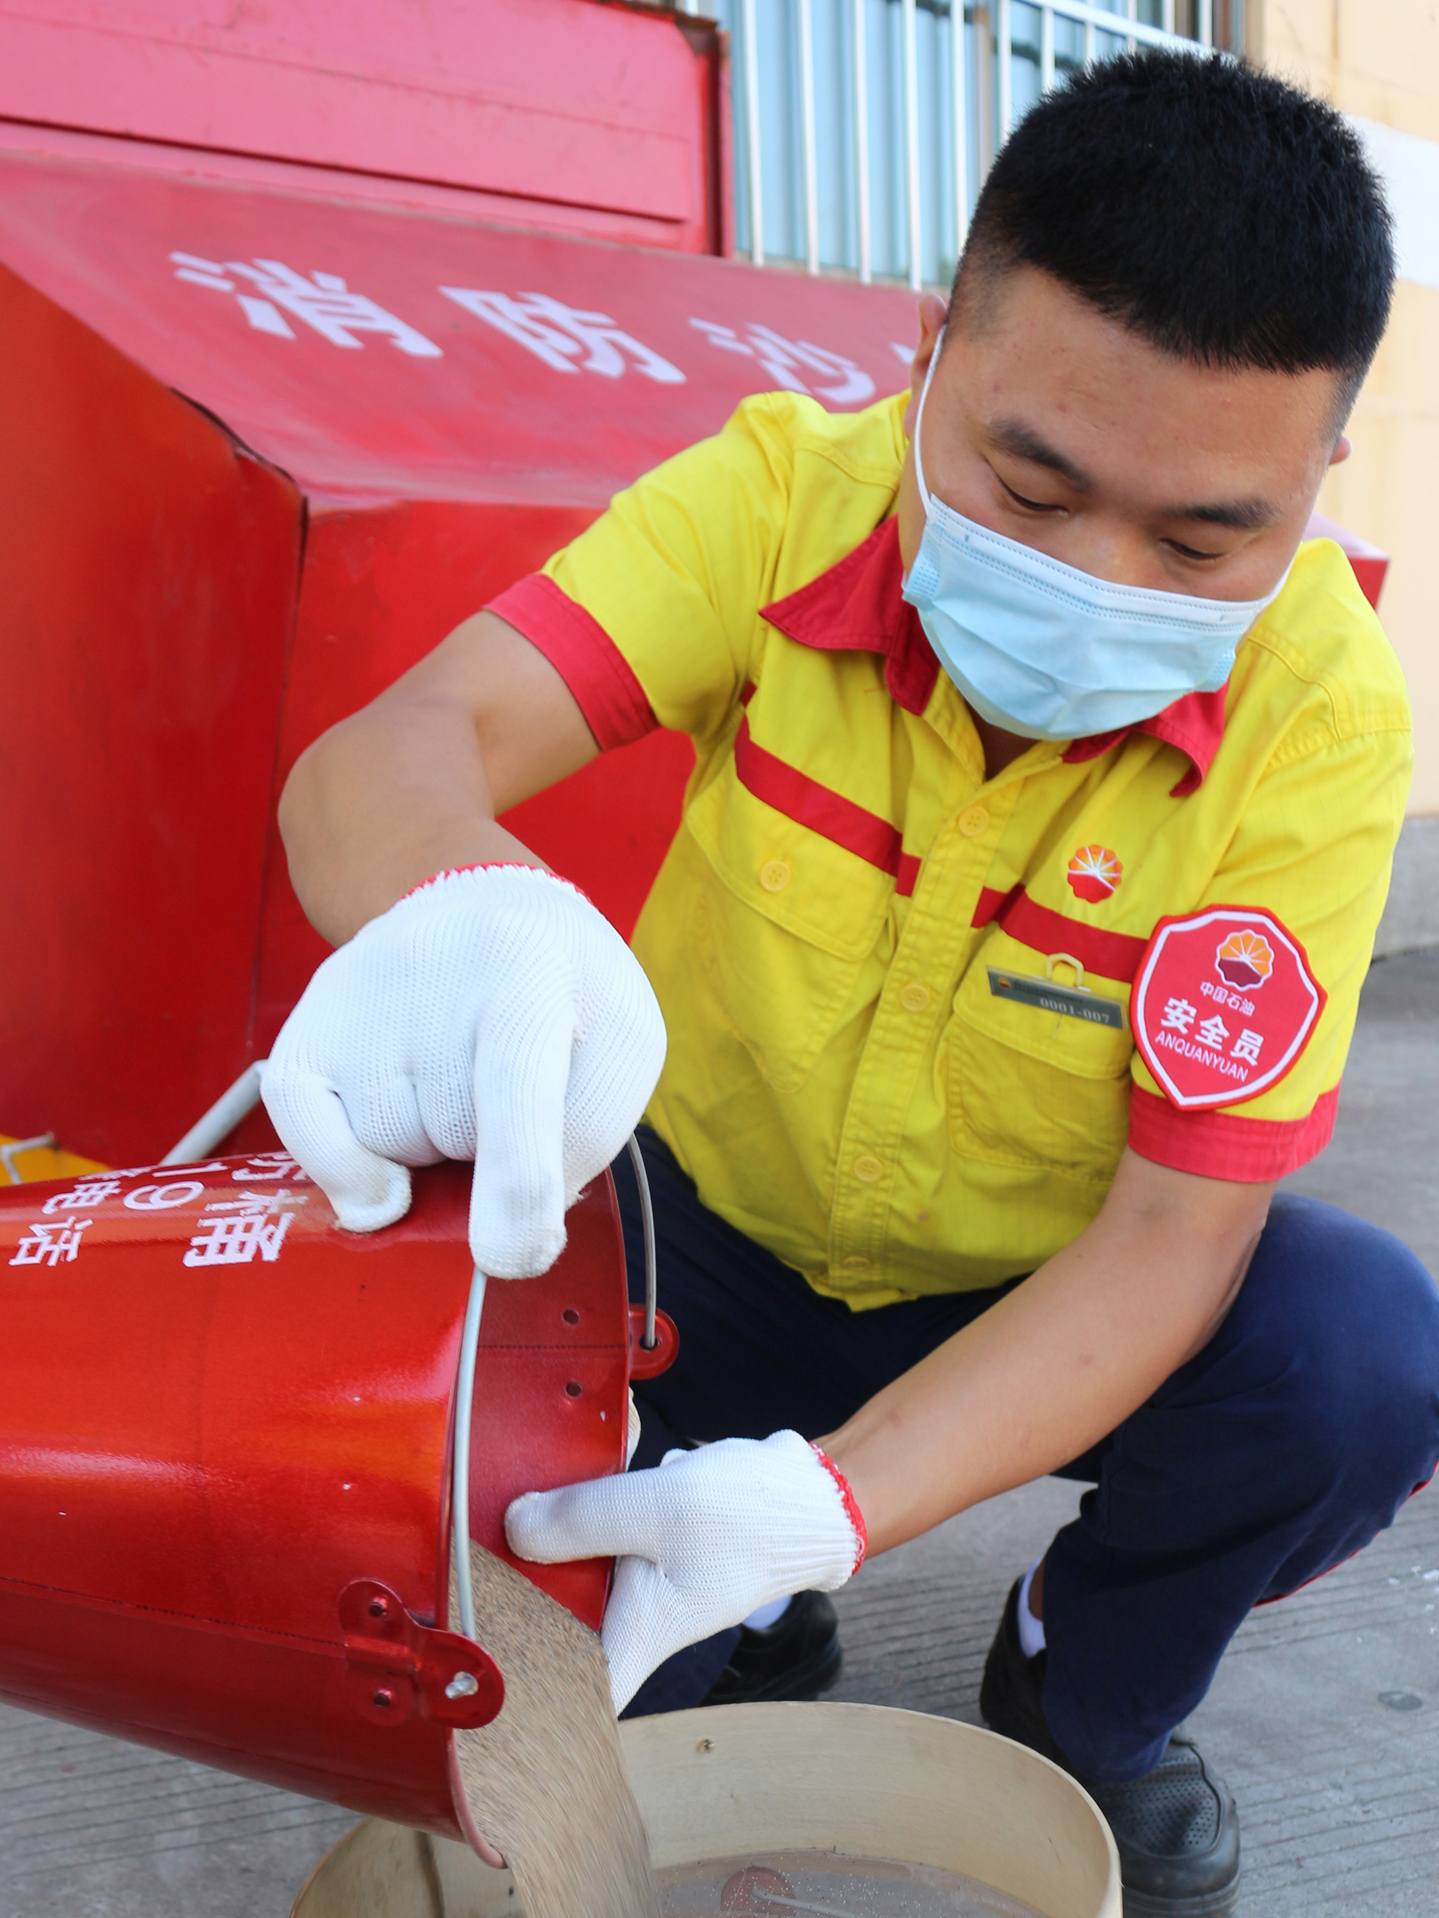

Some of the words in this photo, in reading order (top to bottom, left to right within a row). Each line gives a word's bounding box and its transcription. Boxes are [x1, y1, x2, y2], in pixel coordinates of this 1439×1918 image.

[168, 250, 916, 403] 消防沙
[1039, 997, 1111, 1024] 0001-007
[1200, 981, 1256, 1016] 中国石油
[1155, 1030, 1249, 1082] ANQUANYUAN
[1160, 997, 1264, 1066] 安全员
